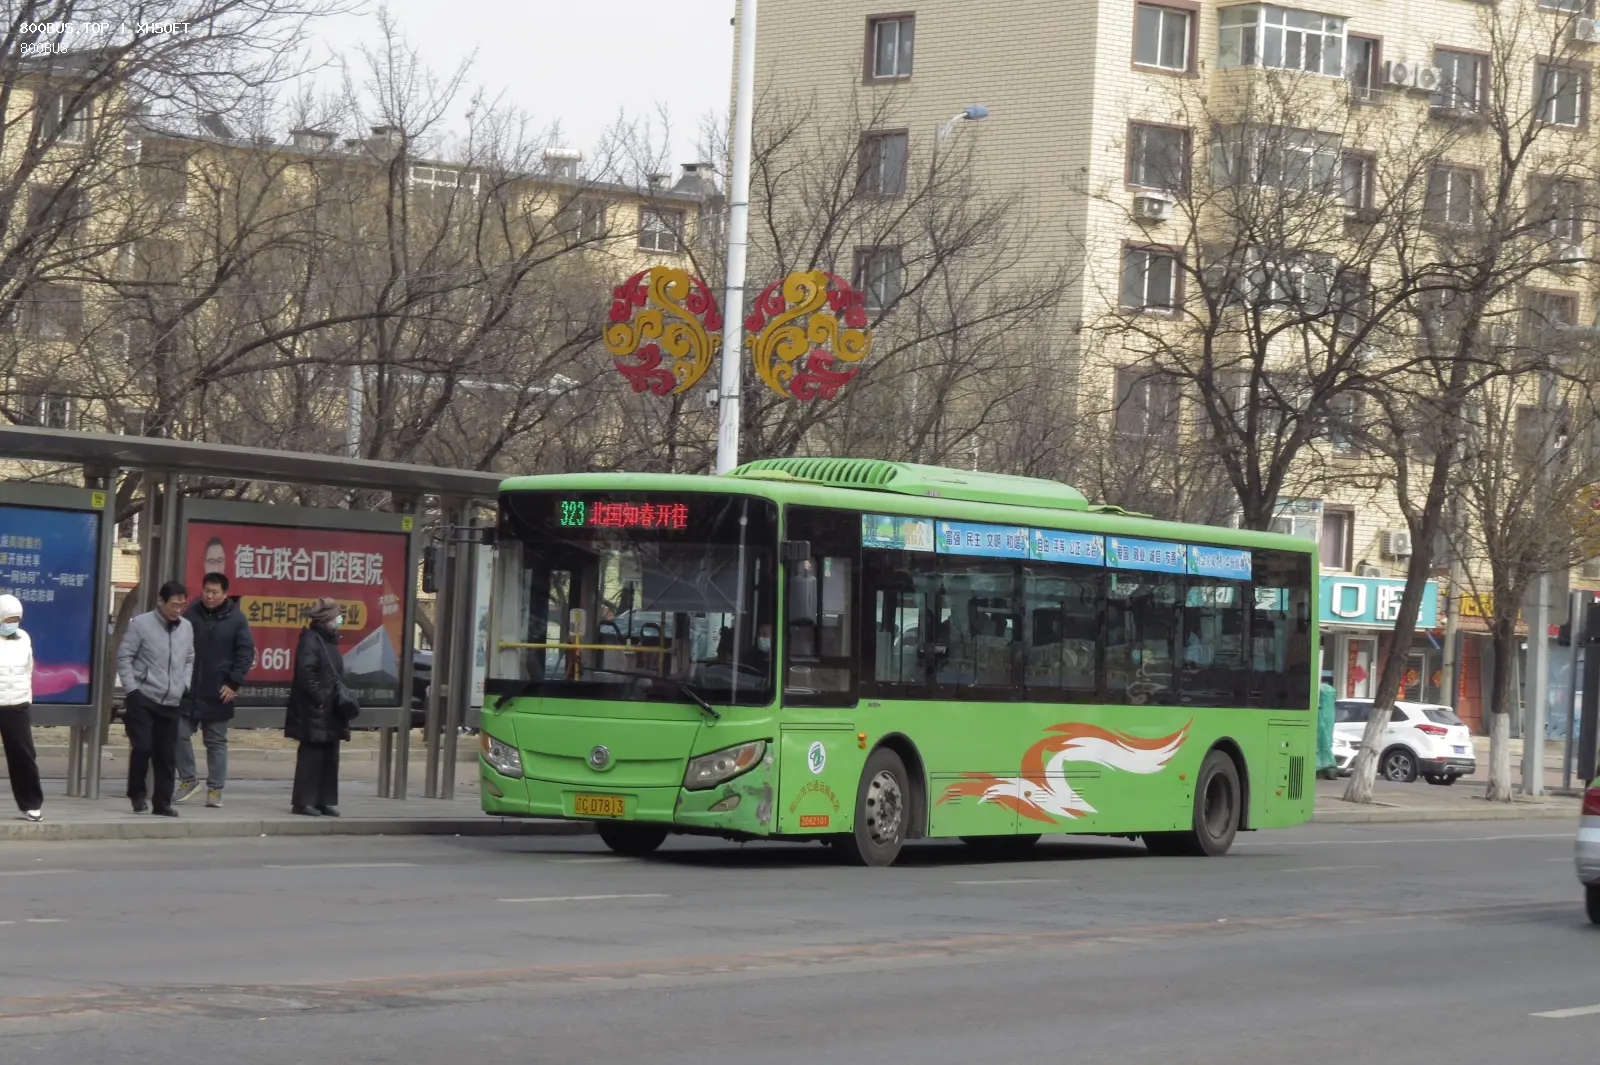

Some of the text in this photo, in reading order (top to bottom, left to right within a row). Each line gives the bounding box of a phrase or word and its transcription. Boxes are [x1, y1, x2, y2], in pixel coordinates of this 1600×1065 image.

[561, 501, 585, 525] 323
[589, 502, 688, 528] 北国知春开往
[946, 530, 960, 546] 富强
[966, 531, 981, 547] 民主
[987, 533, 1001, 548] 文明
[1006, 534, 1021, 549] 和谐
[234, 544, 383, 585] 德立联合口腔医院
